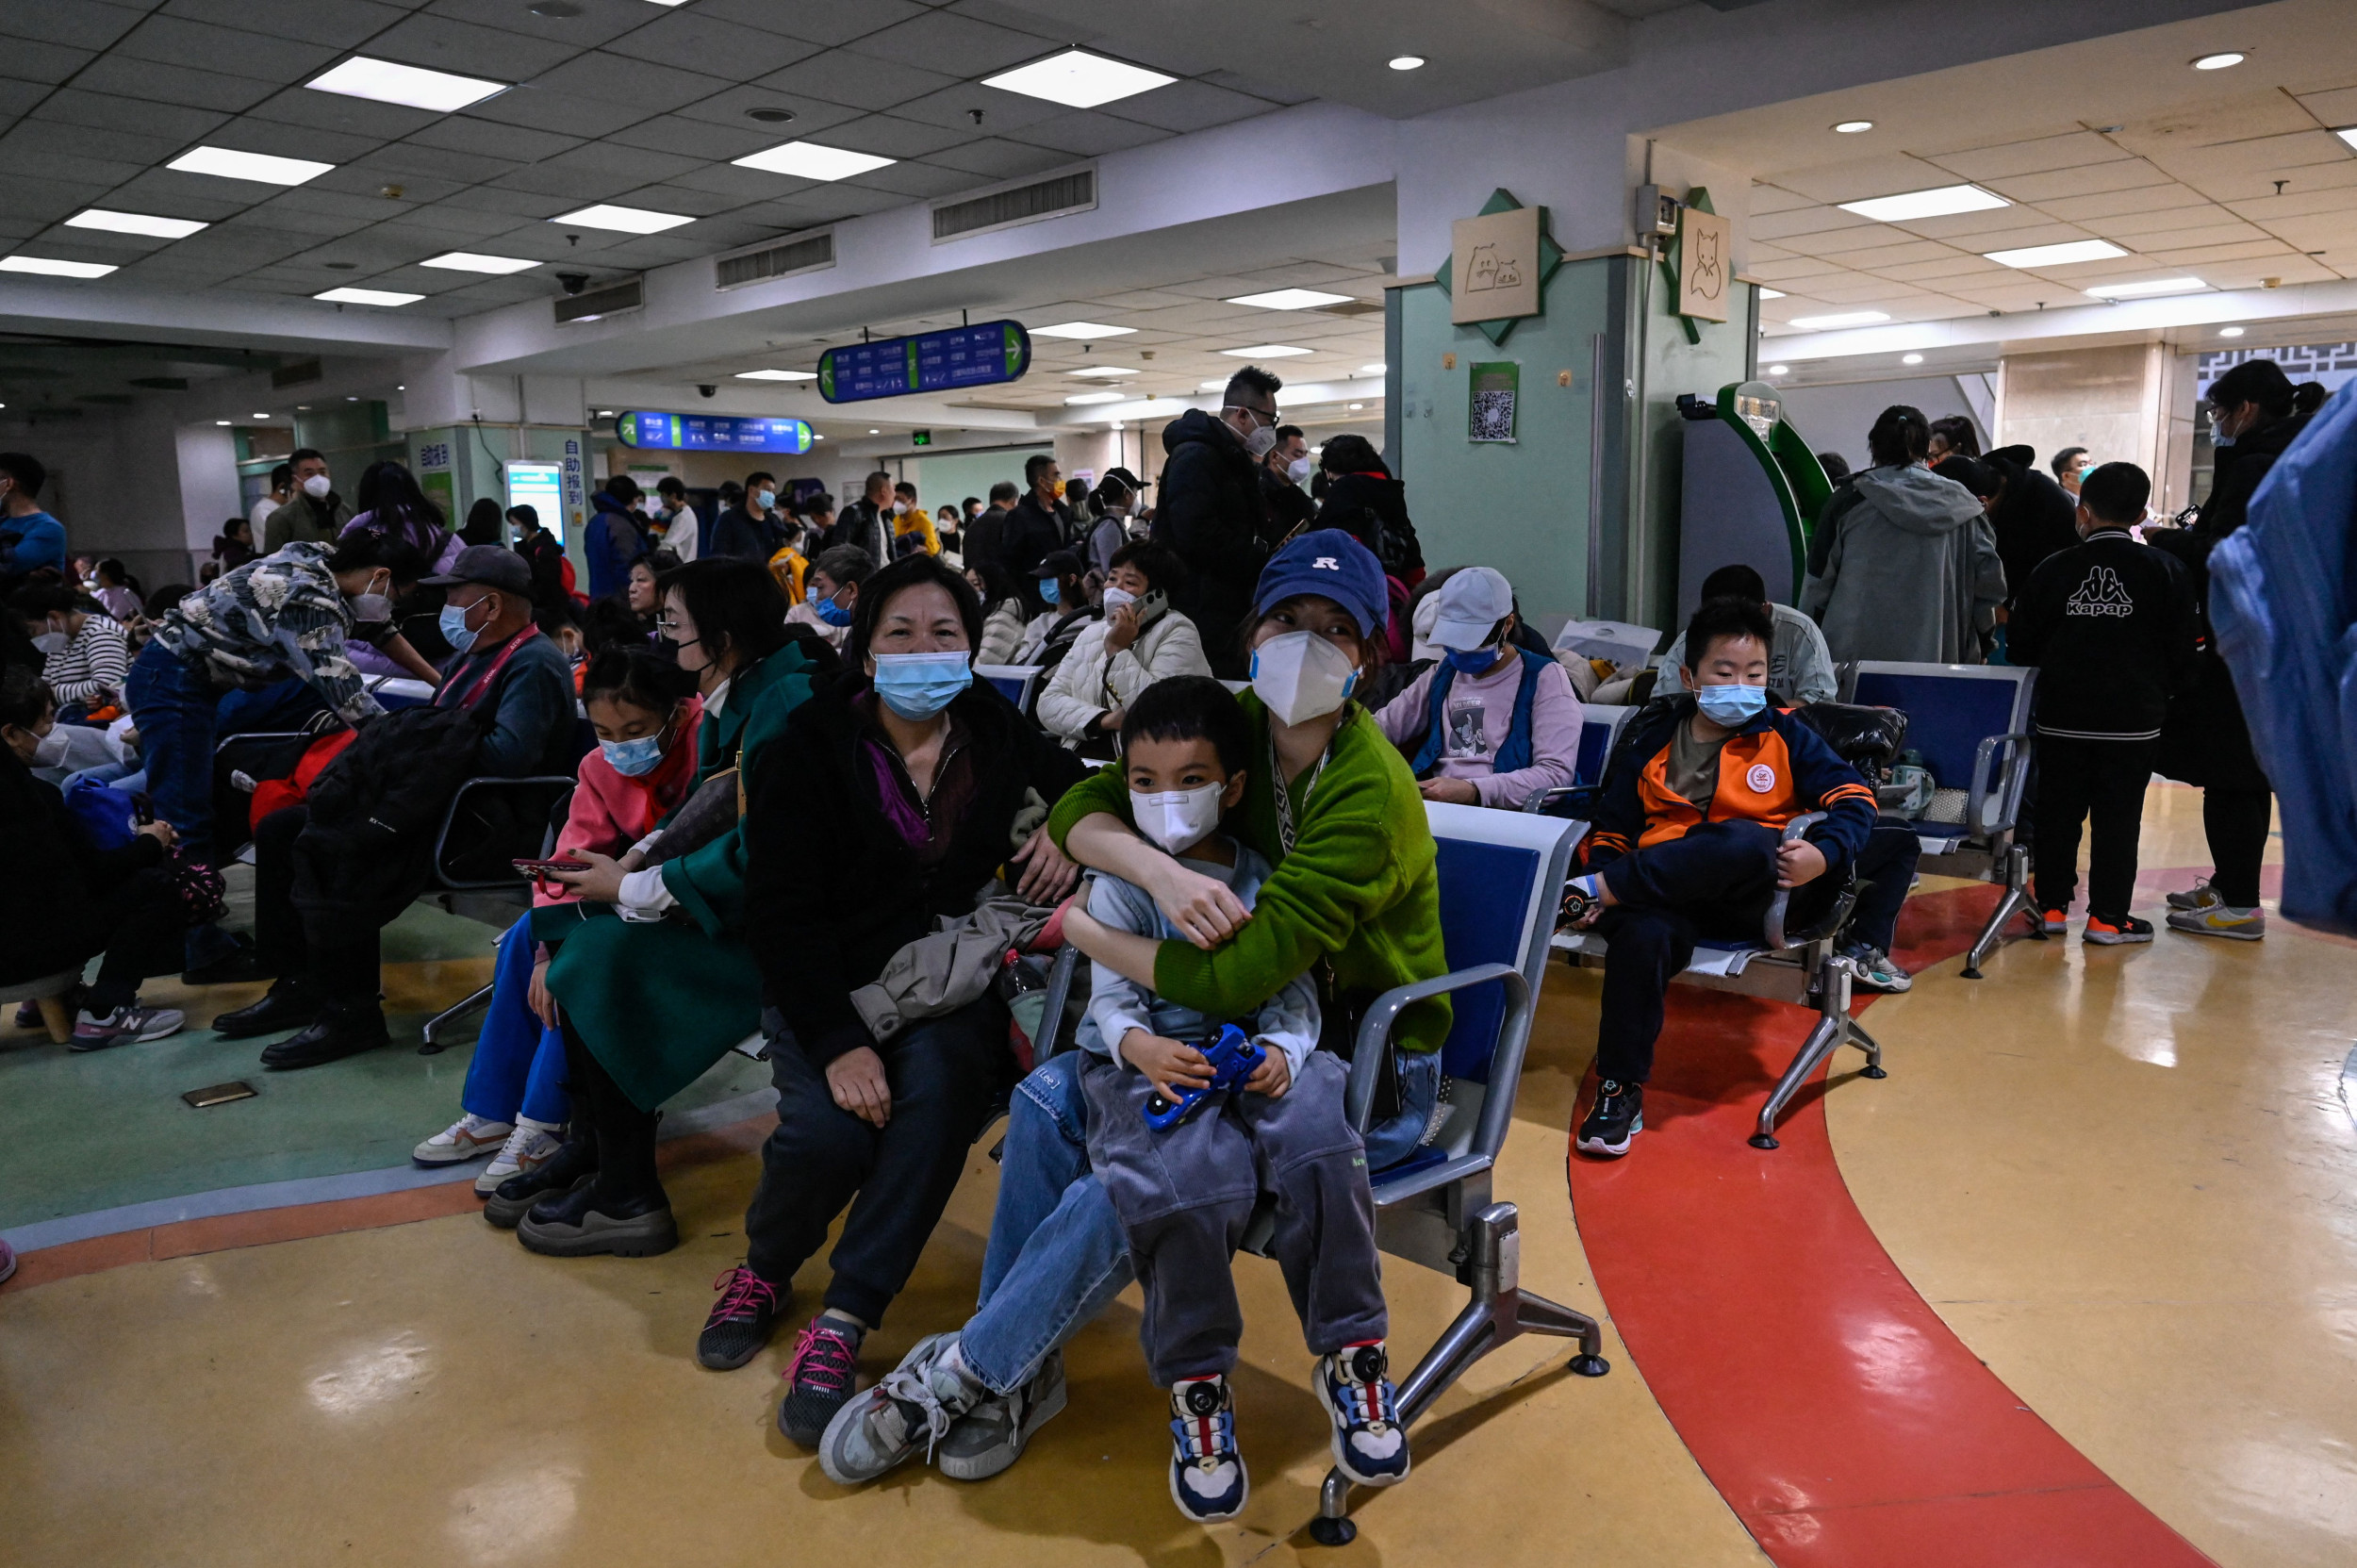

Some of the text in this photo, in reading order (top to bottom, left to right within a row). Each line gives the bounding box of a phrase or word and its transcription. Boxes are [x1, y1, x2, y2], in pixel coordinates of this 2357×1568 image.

[566, 438, 583, 506] 自助报到
[1312, 556, 1340, 571] R
[2066, 602, 2134, 618] Kapap
[121, 1015, 142, 1031] N
